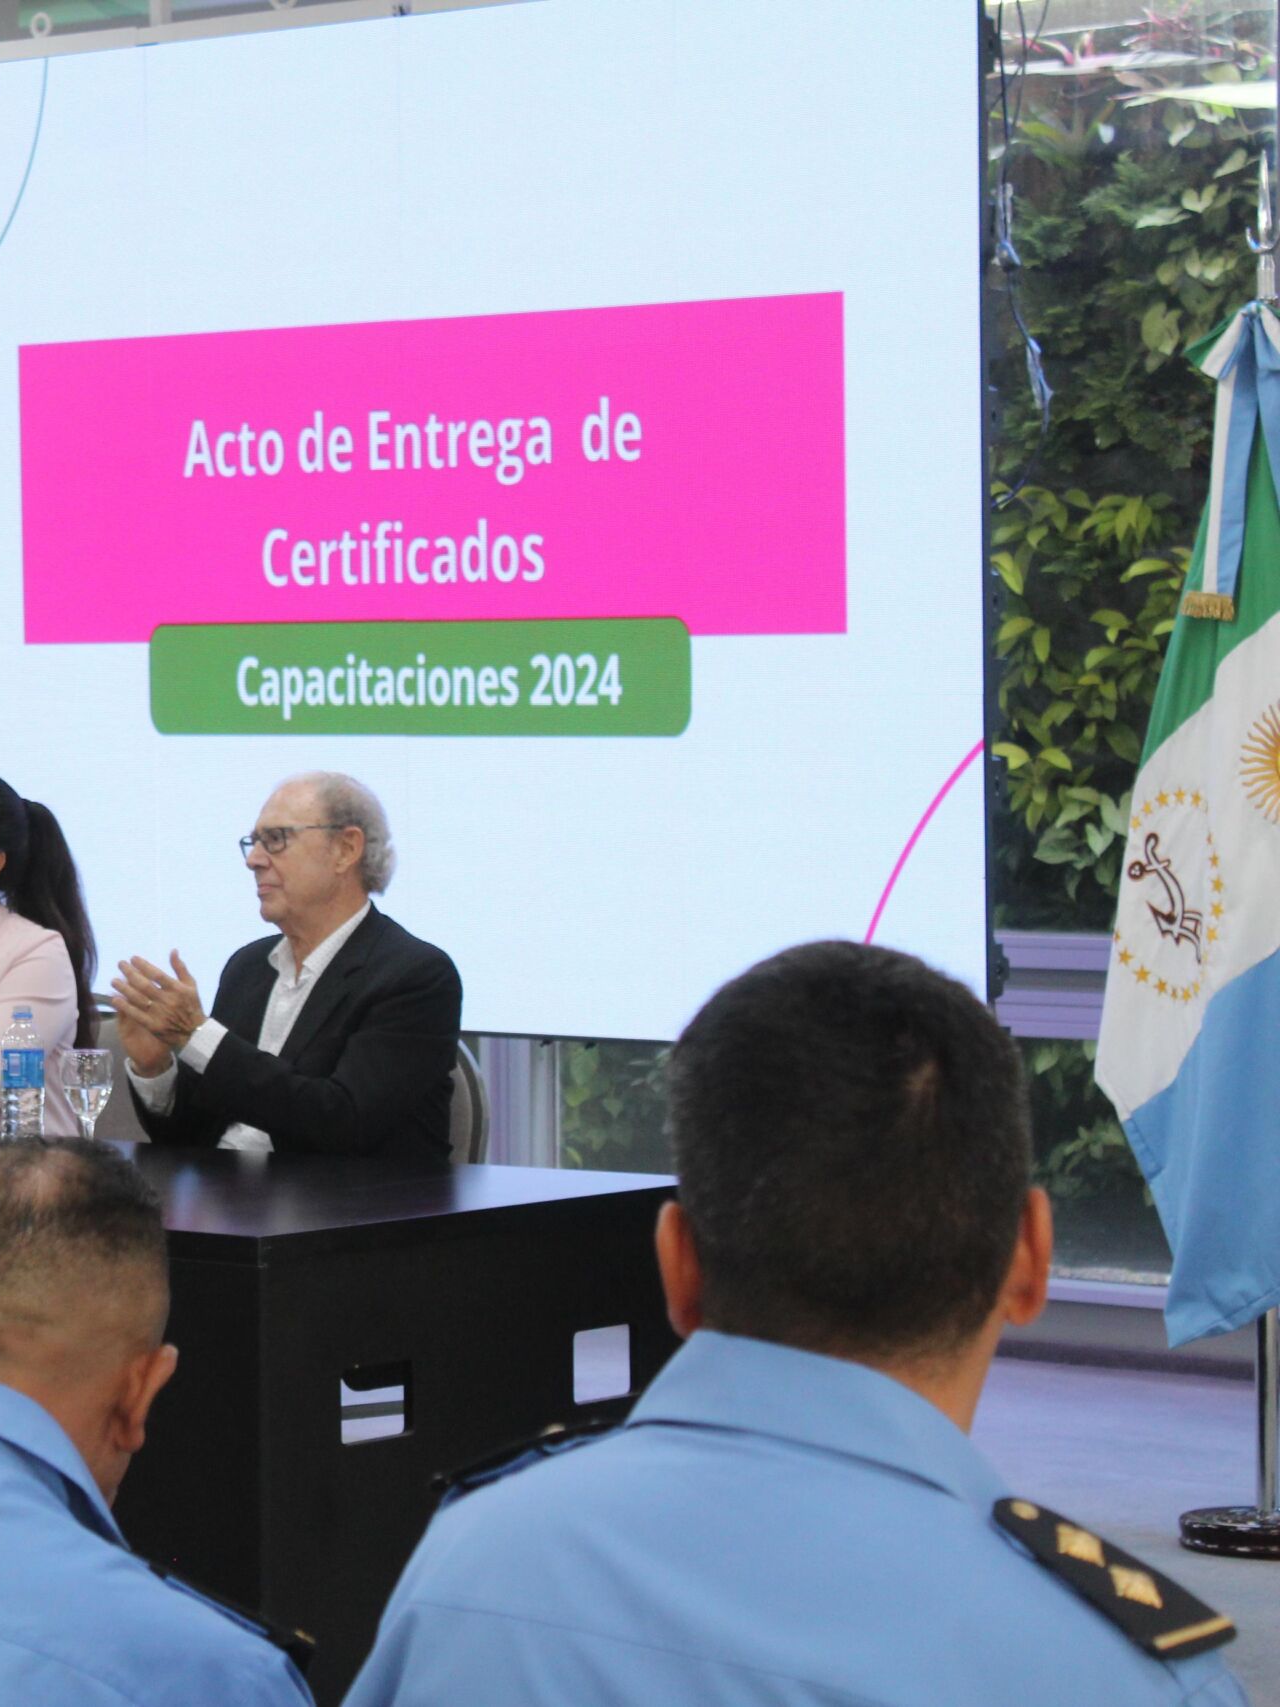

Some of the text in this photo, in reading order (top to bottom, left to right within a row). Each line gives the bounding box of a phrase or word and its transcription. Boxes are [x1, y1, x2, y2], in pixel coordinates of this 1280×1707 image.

[182, 396, 643, 486] Acto de Entrega de
[261, 518, 545, 587] Certificados
[236, 652, 623, 720] Capacitaciones 2024
